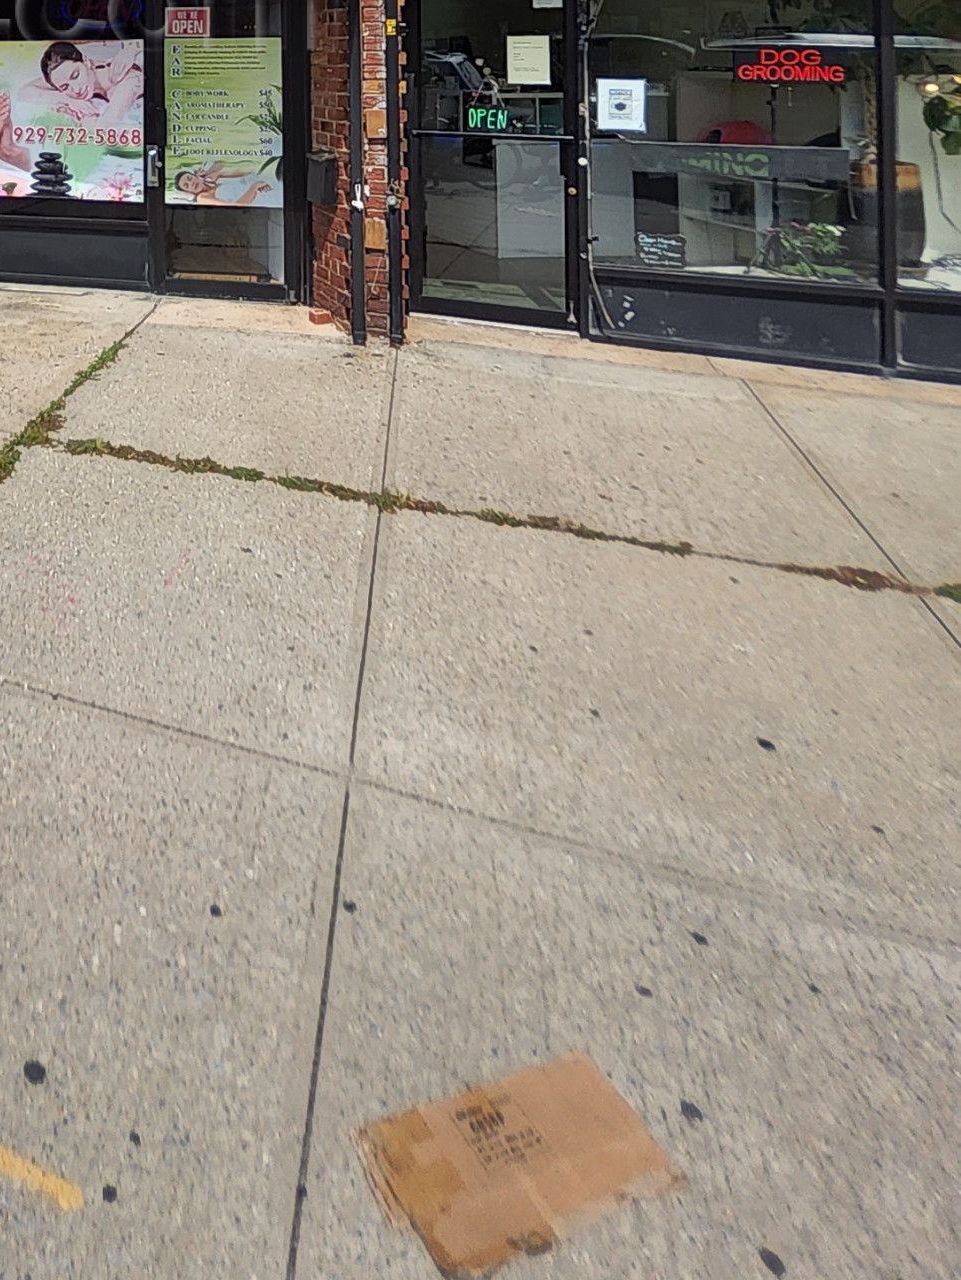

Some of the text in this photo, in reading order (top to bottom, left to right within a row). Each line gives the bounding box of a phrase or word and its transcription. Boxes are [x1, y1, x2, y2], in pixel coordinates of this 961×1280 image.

[172, 20, 203, 33] OPEN
[759, 49, 821, 65] DOG
[738, 65, 845, 82] GROOMING
[469, 107, 508, 130] OPEN
[14, 127, 141, 145] 929-732-5868
